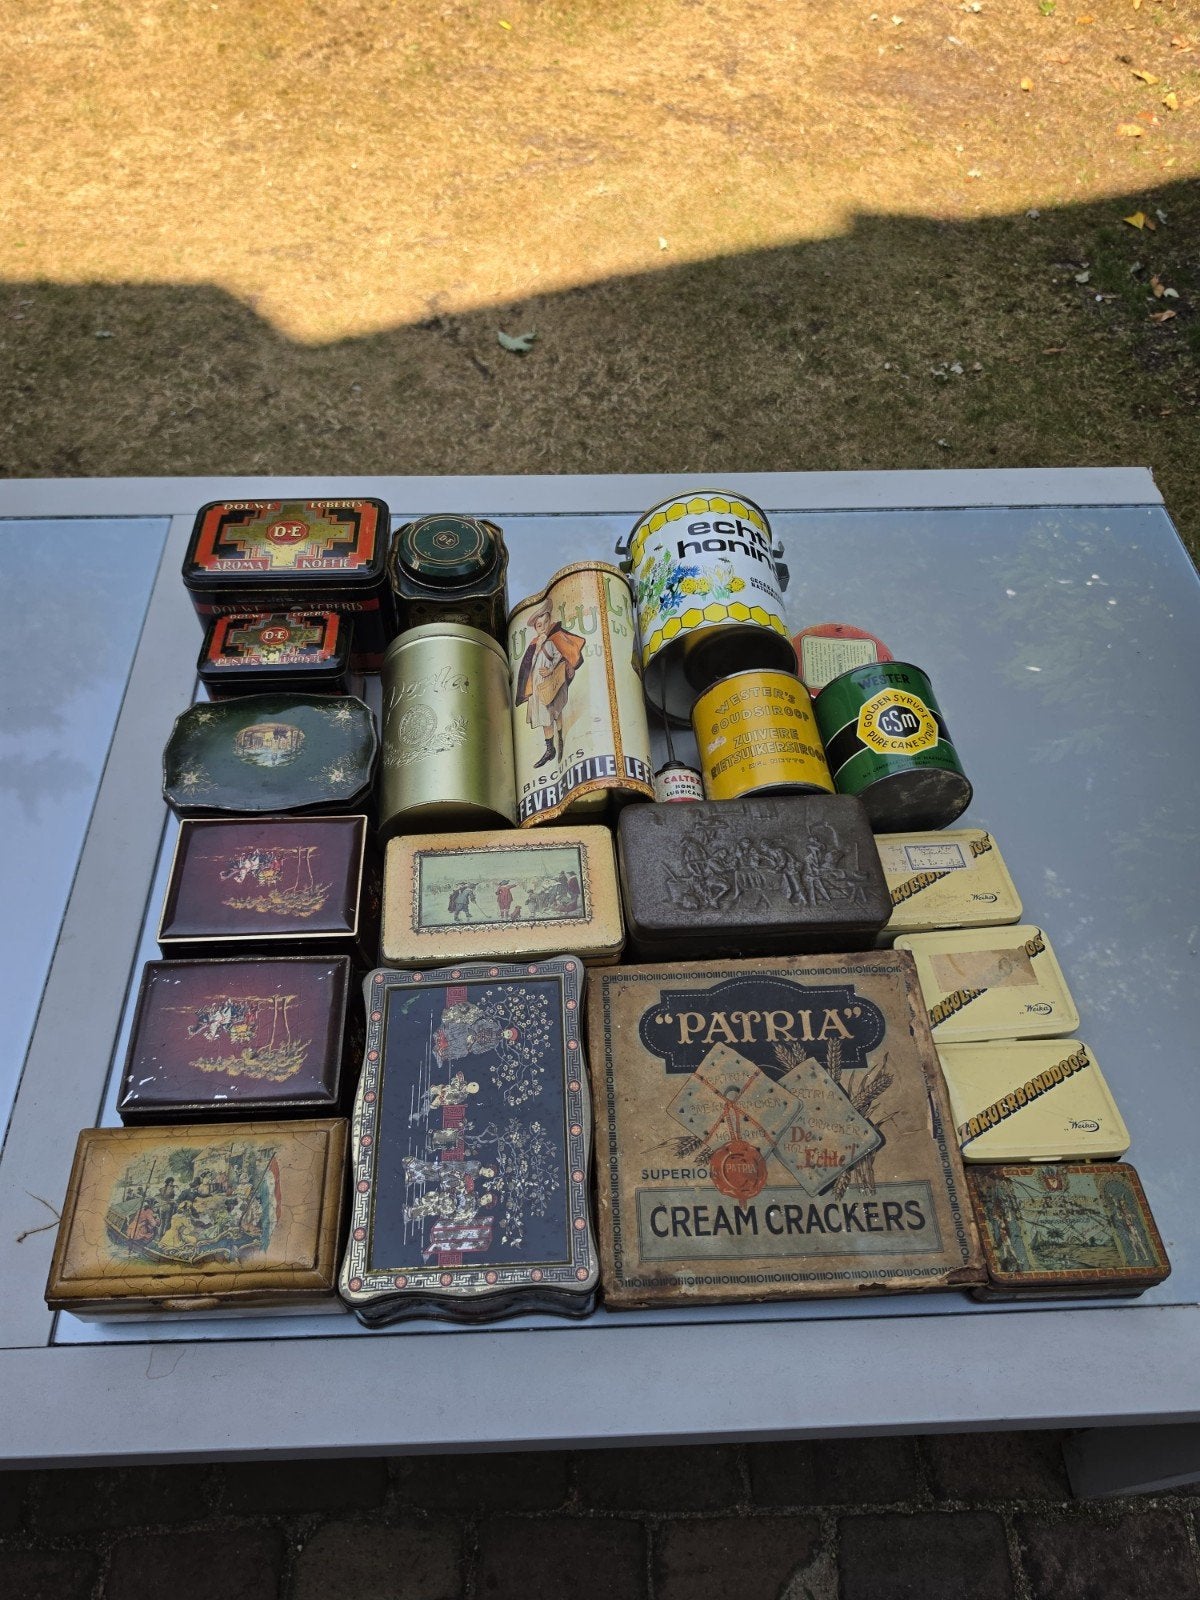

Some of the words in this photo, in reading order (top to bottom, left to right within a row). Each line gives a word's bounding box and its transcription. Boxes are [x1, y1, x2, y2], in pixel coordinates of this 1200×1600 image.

[223, 502, 275, 510] DOUWE
[310, 501, 363, 509] EGBERTS
[687, 519, 770, 553] echt
[213, 560, 264, 570] AROMA
[302, 558, 351, 569] KOFFIE
[857, 674, 911, 689] WESTER
[715, 687, 796, 715] WESTER'S
[863, 695, 891, 727] GOLDEN
[893, 694, 924, 714] SYRUP
[711, 705, 810, 735] GOUDSIROOP
[734, 728, 799, 749] ZUIVERE
[867, 731, 889, 748] PURE
[891, 740, 919, 749] CANE
[918, 722, 934, 745] SYRUP
[523, 748, 585, 794] BISCUITS
[790, 1125, 812, 1143] De
[650, 1203, 759, 1238] CREAM
[765, 1200, 926, 1236] CRACKERS
